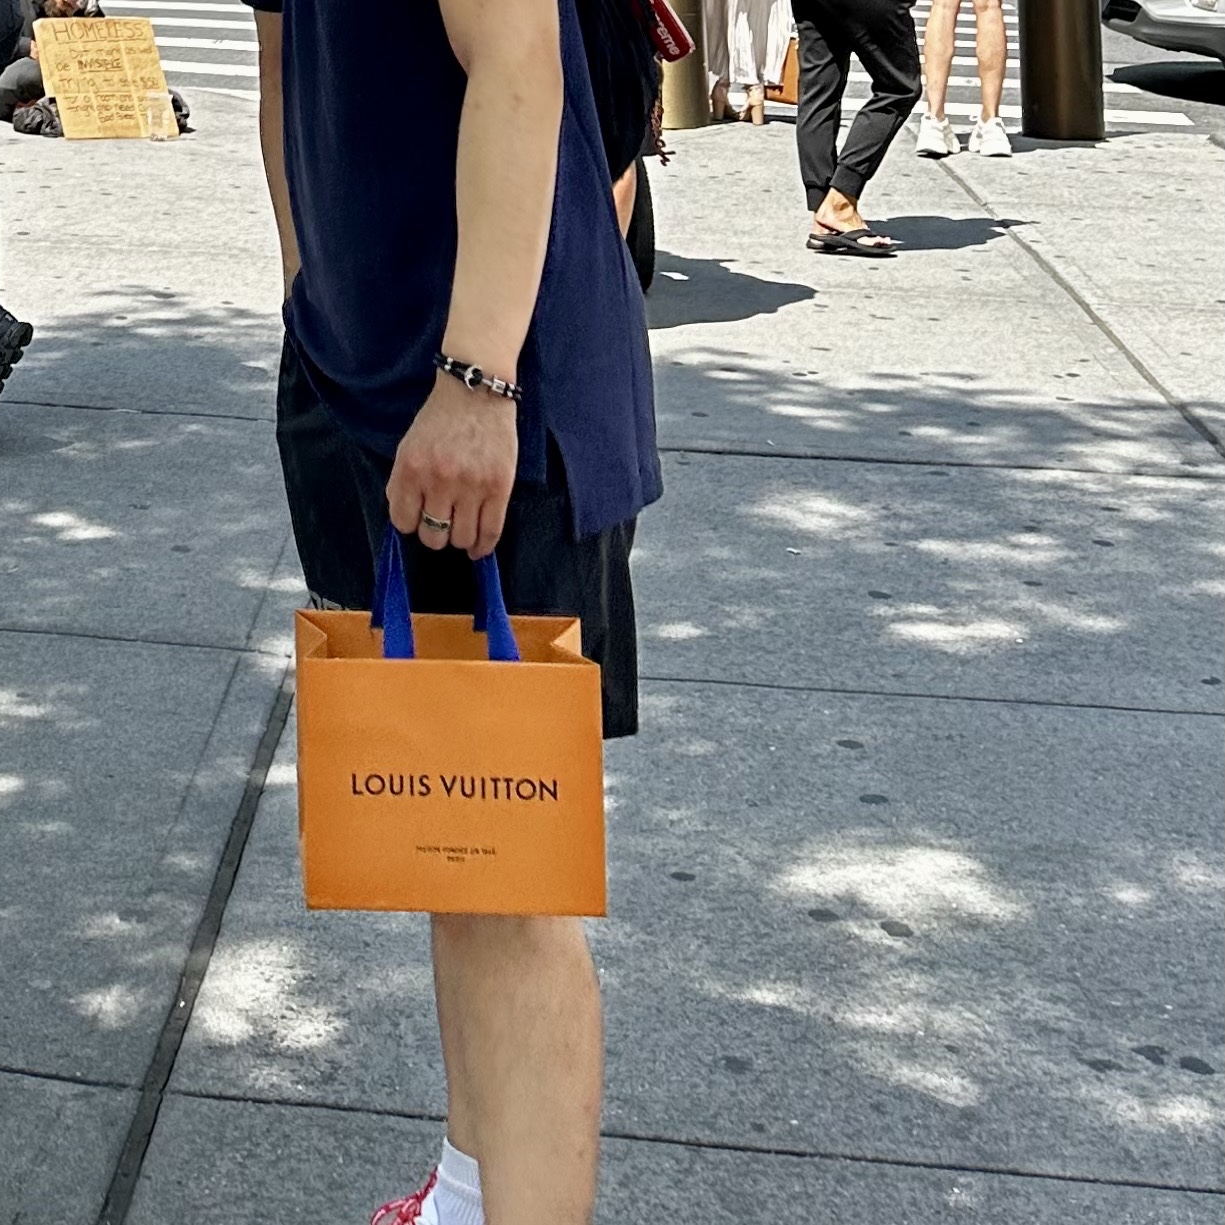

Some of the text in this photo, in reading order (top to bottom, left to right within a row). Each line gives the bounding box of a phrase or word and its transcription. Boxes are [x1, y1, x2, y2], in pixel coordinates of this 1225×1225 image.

[51, 21, 145, 42] HOMELESS
[351, 773, 559, 801] LOUIS VUITTON
